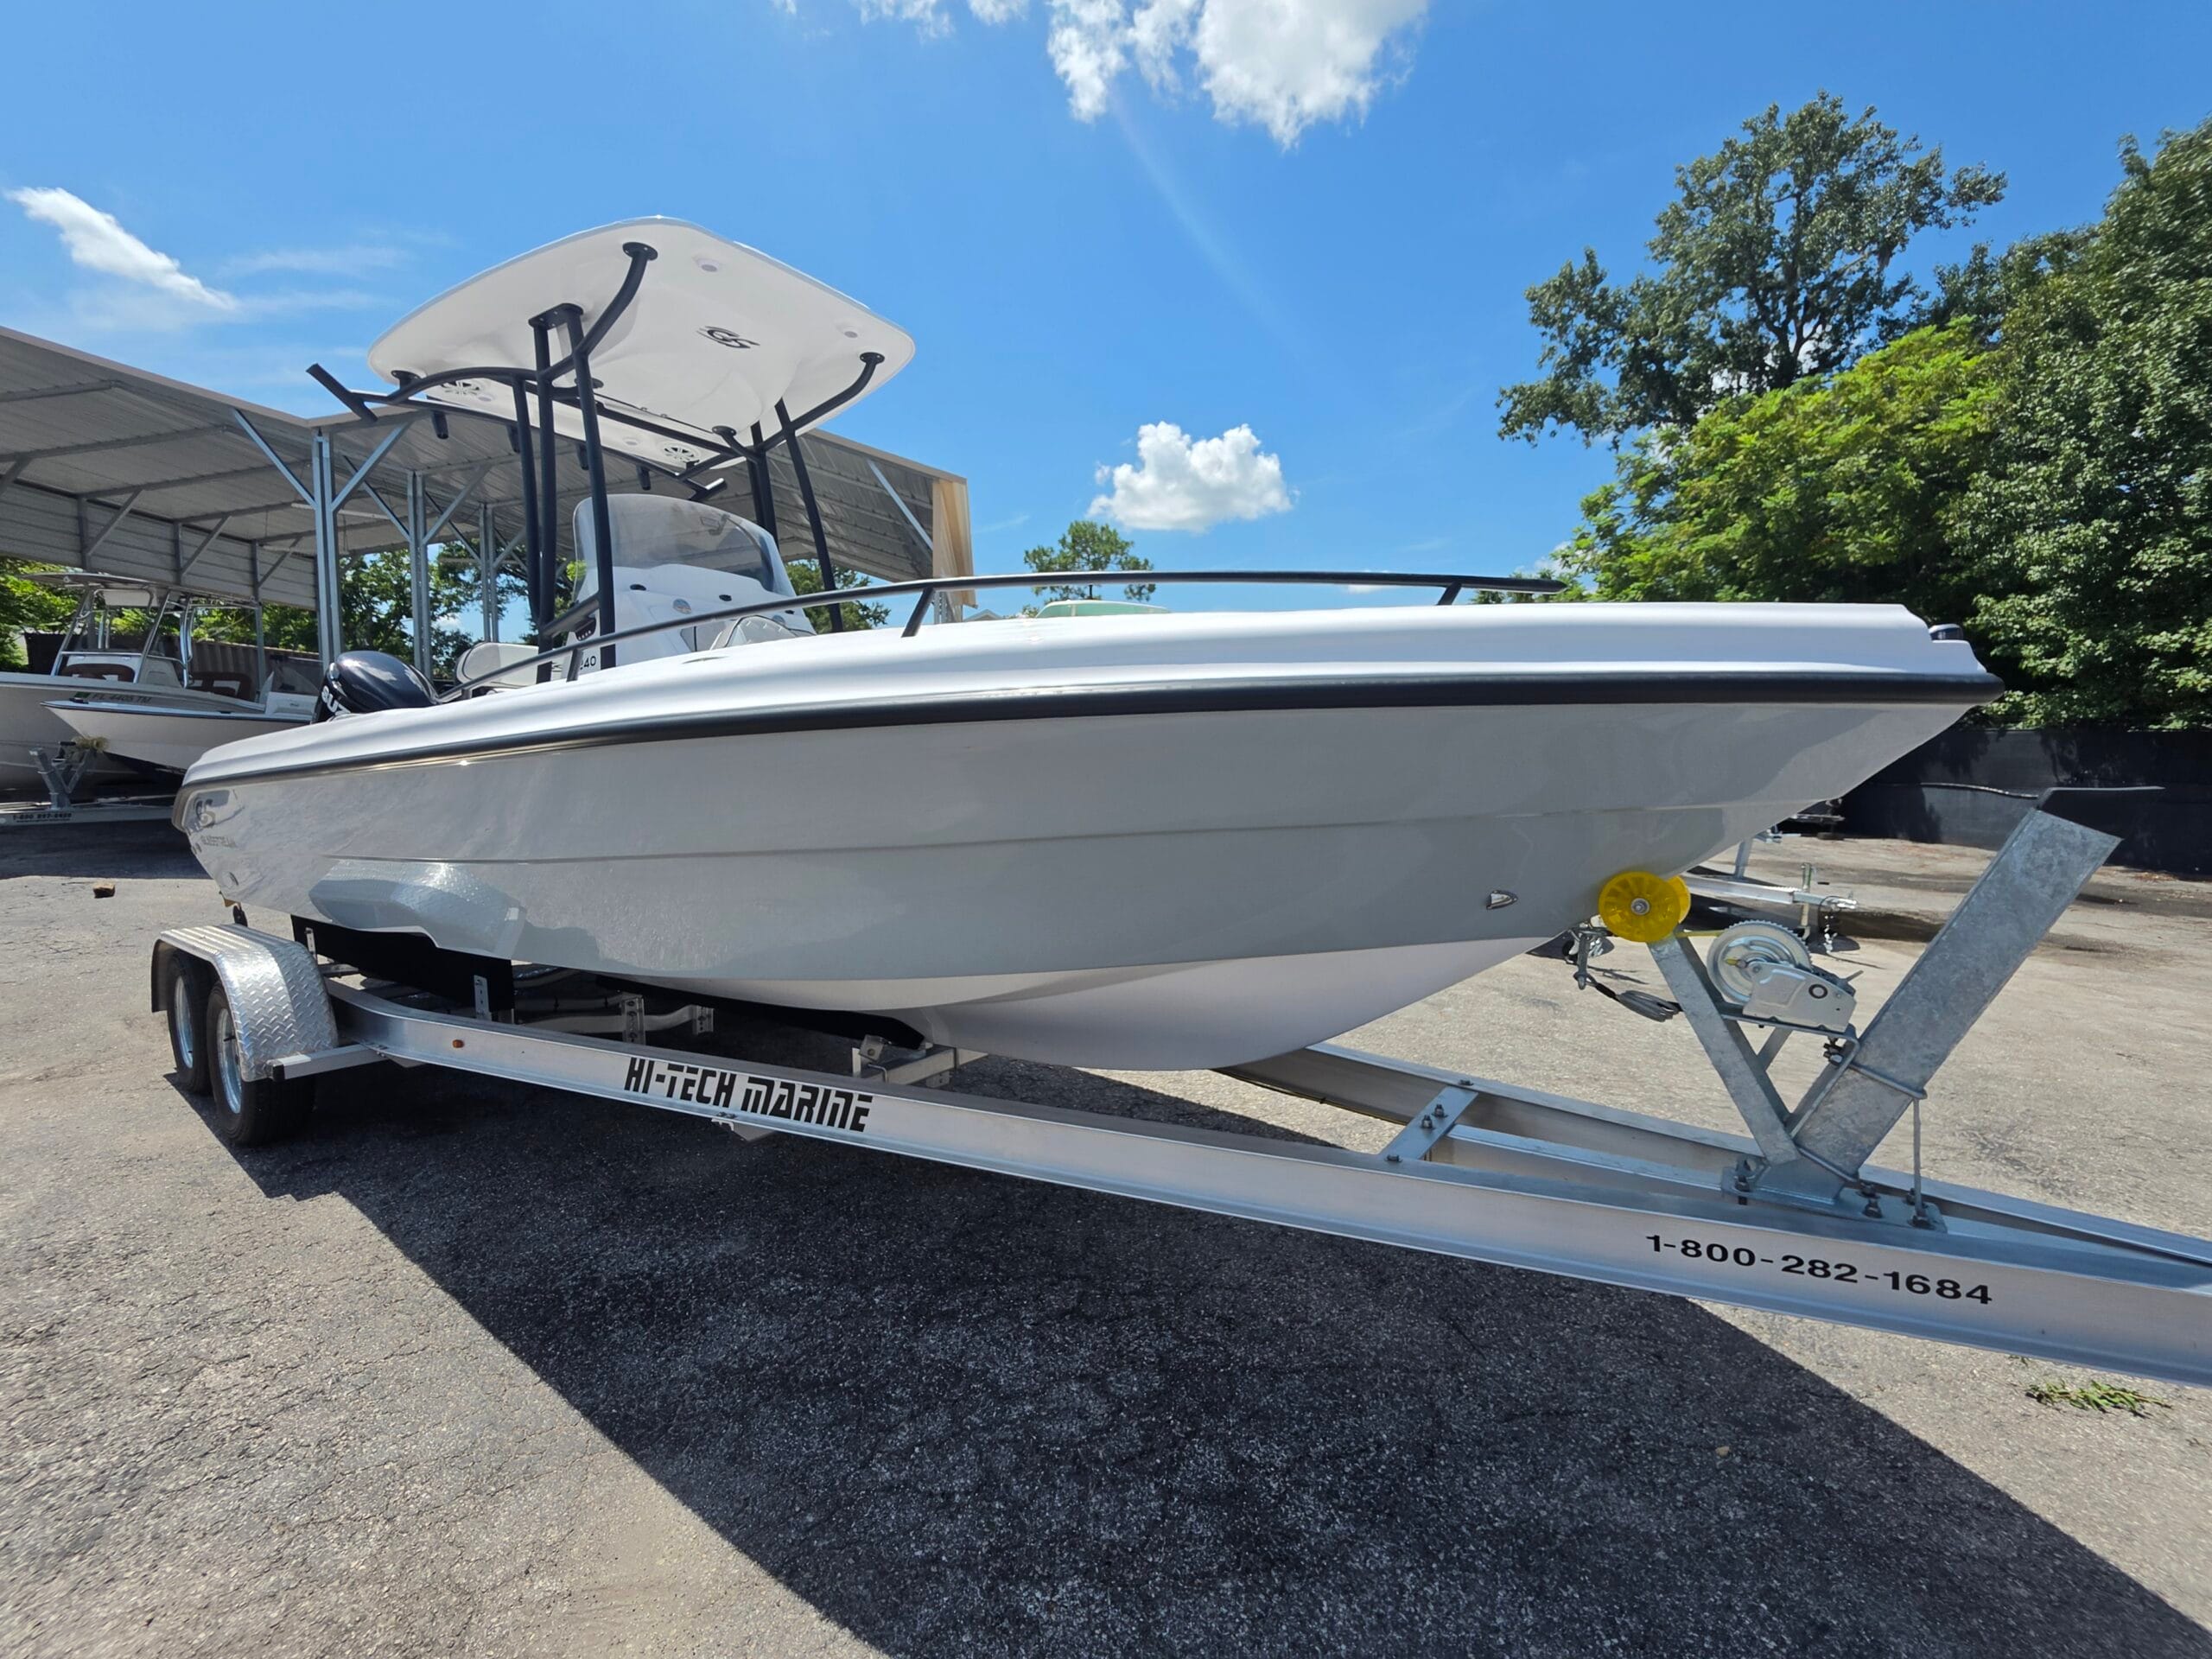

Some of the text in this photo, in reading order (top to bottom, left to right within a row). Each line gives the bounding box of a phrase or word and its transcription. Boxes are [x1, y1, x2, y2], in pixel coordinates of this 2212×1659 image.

[580, 655, 597, 671] 40
[623, 1056, 874, 1133] HI-TECH MARINE
[1645, 1234, 1993, 1305] 1-800-282-1684
